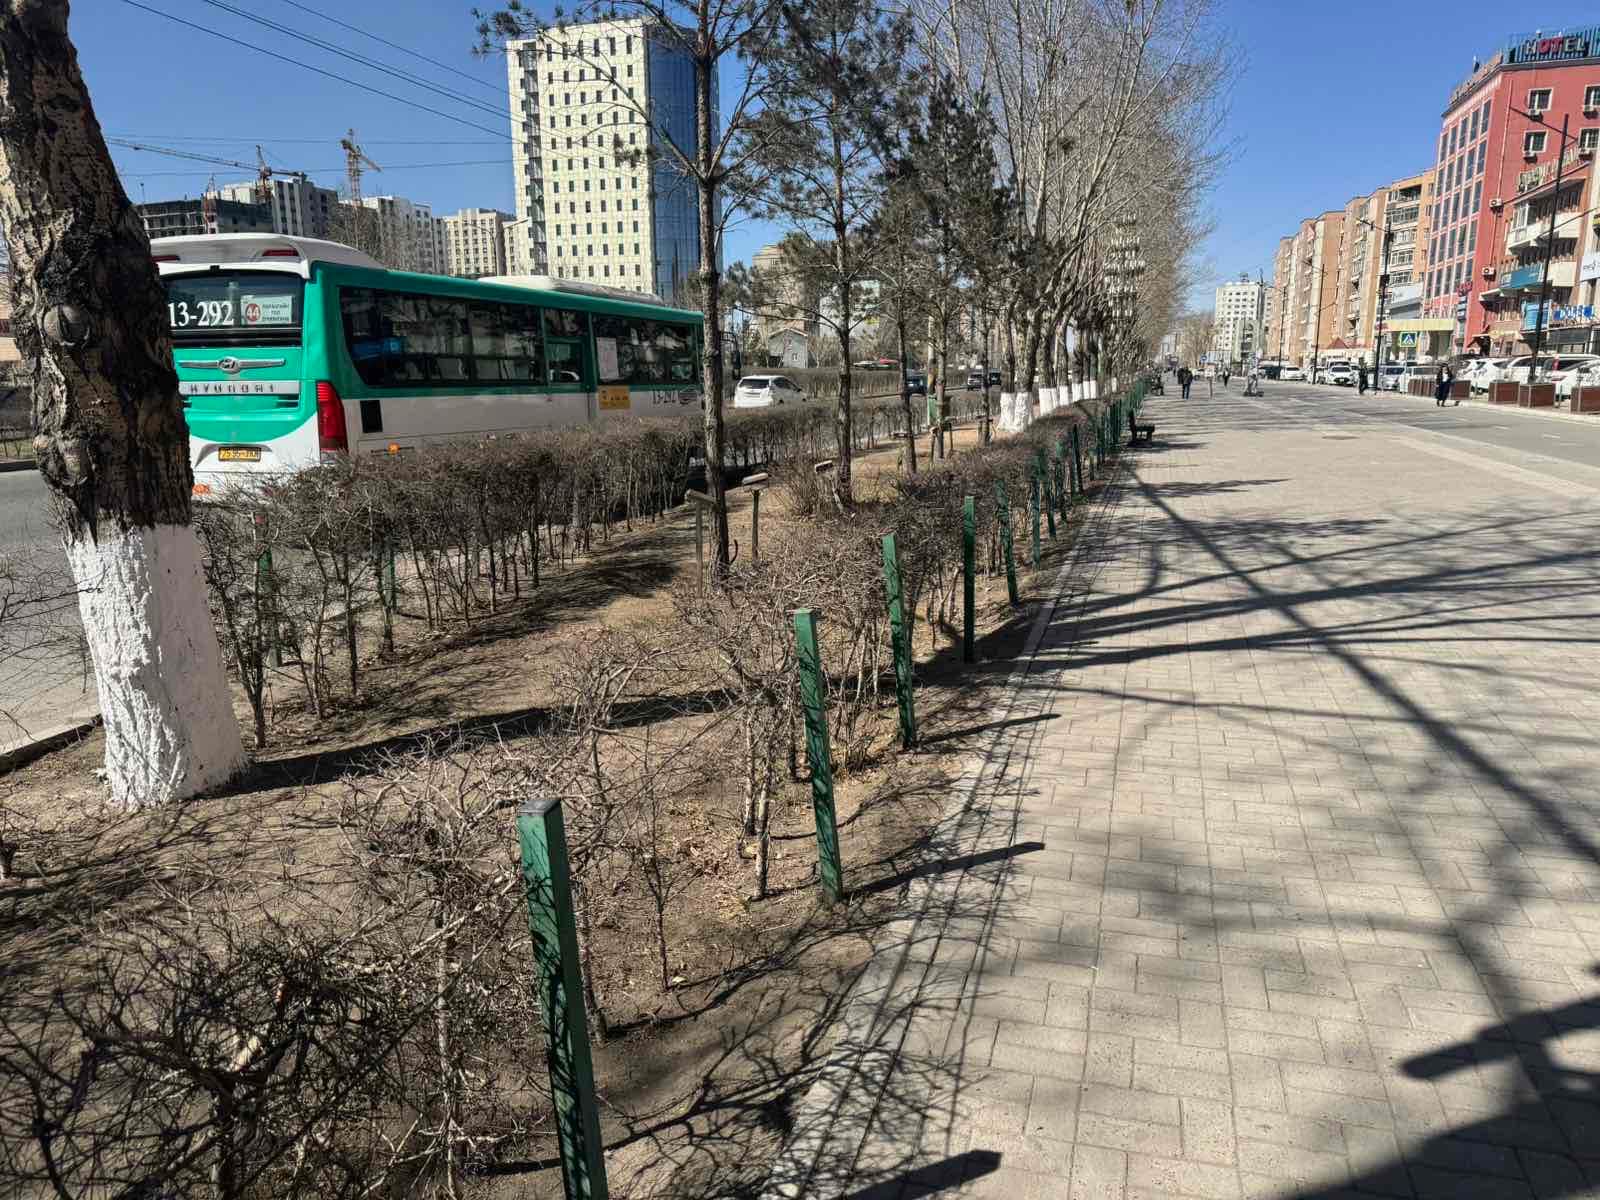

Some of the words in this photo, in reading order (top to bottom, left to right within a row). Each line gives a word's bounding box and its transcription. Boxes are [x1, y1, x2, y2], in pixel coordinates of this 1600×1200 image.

[1526, 35, 1586, 55] HOTEL
[168, 301, 235, 327] 13-292
[246, 307, 260, 318] 44
[190, 383, 275, 393] HYUNDAI
